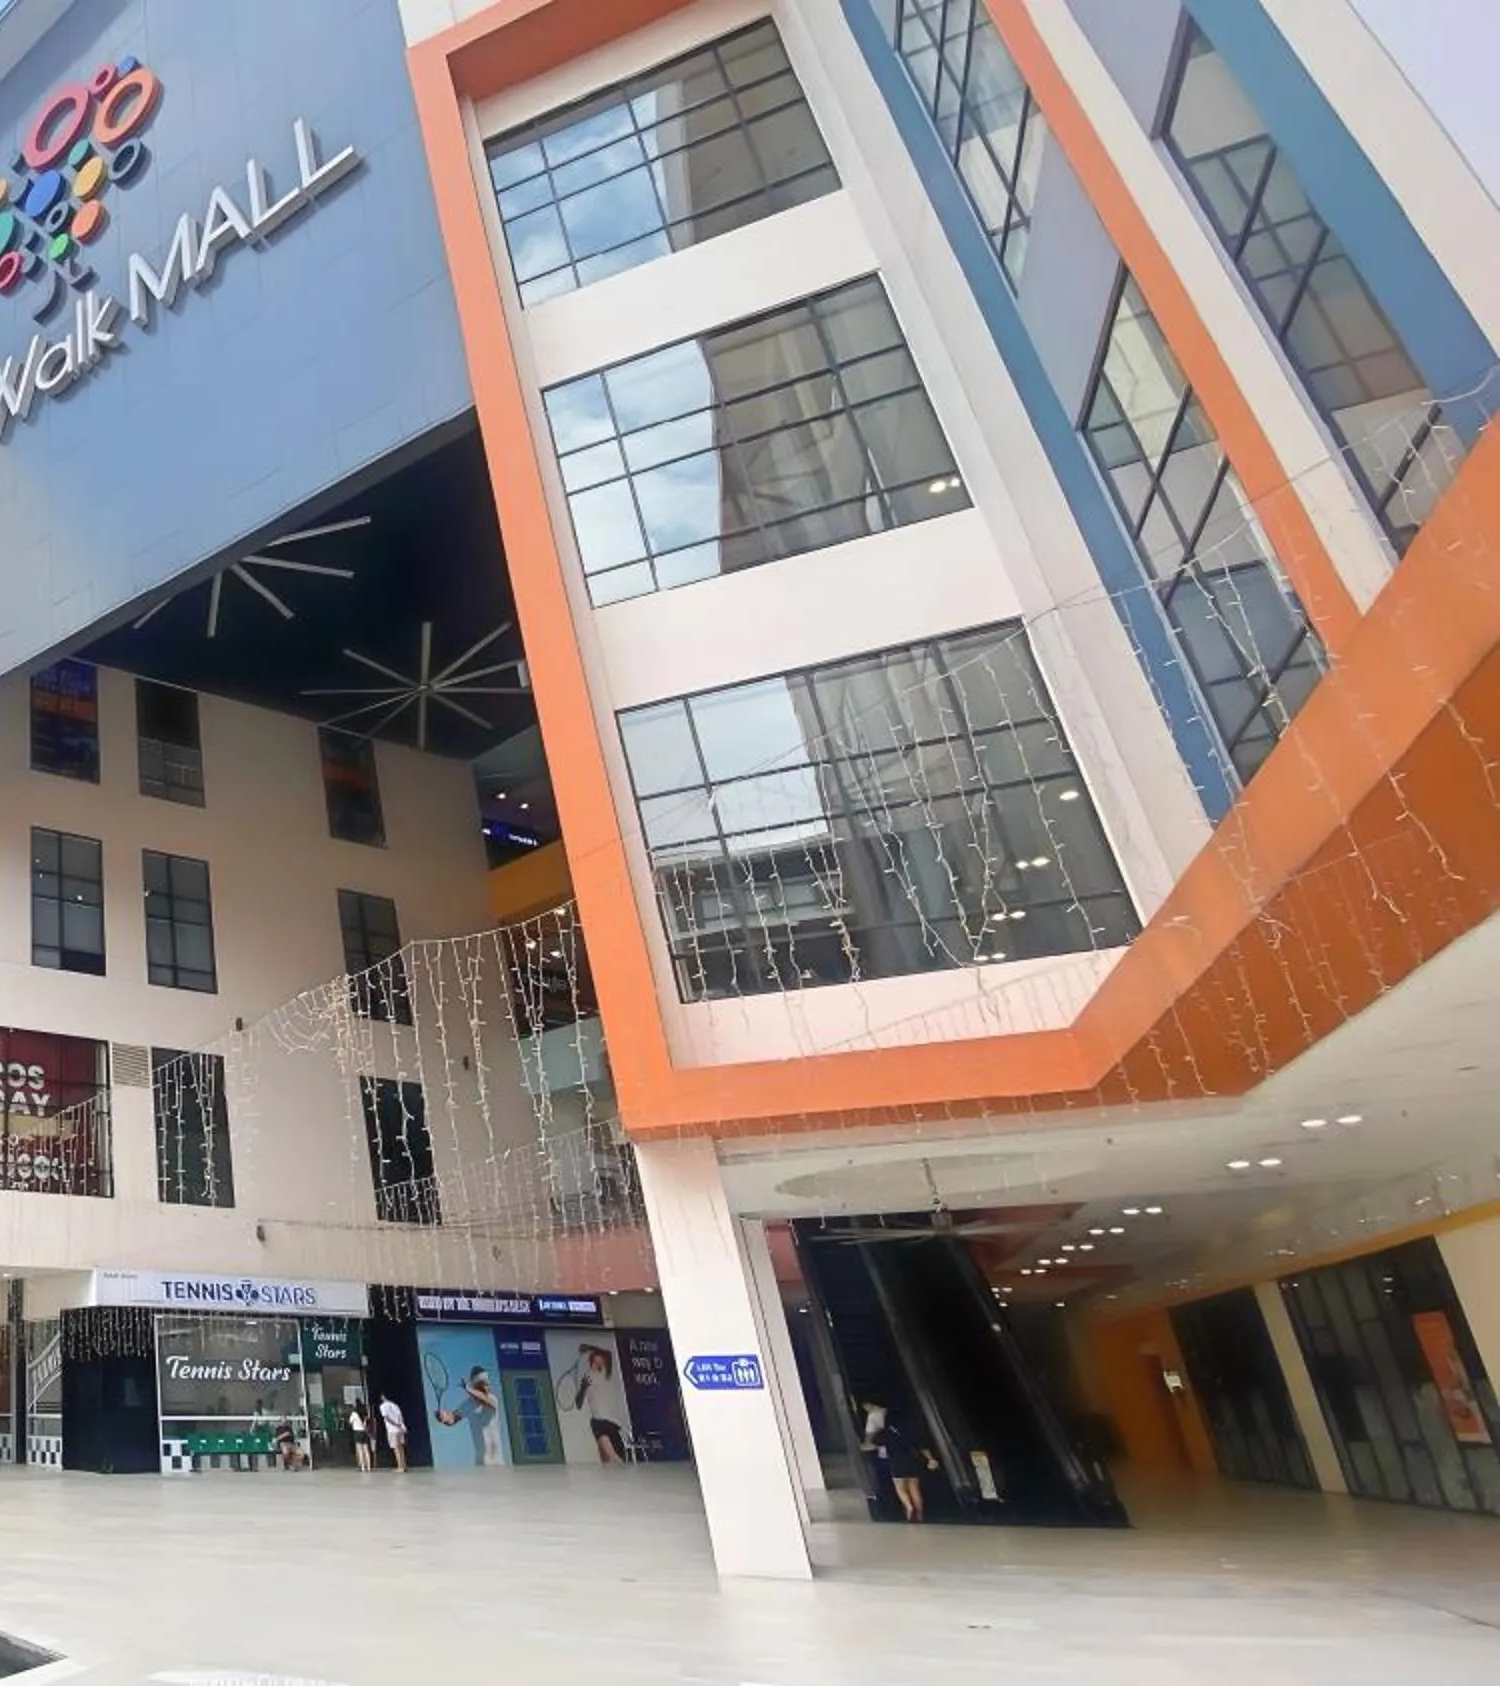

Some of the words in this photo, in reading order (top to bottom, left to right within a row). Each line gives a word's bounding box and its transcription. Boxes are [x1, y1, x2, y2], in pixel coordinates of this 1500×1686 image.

[128, 115, 362, 328] MALL
[161, 1281, 233, 1301] TENNIS
[261, 1286, 316, 1305] STARS
[316, 1344, 347, 1359] Stars
[166, 1355, 233, 1379] Tennis
[238, 1357, 291, 1381] Stars
